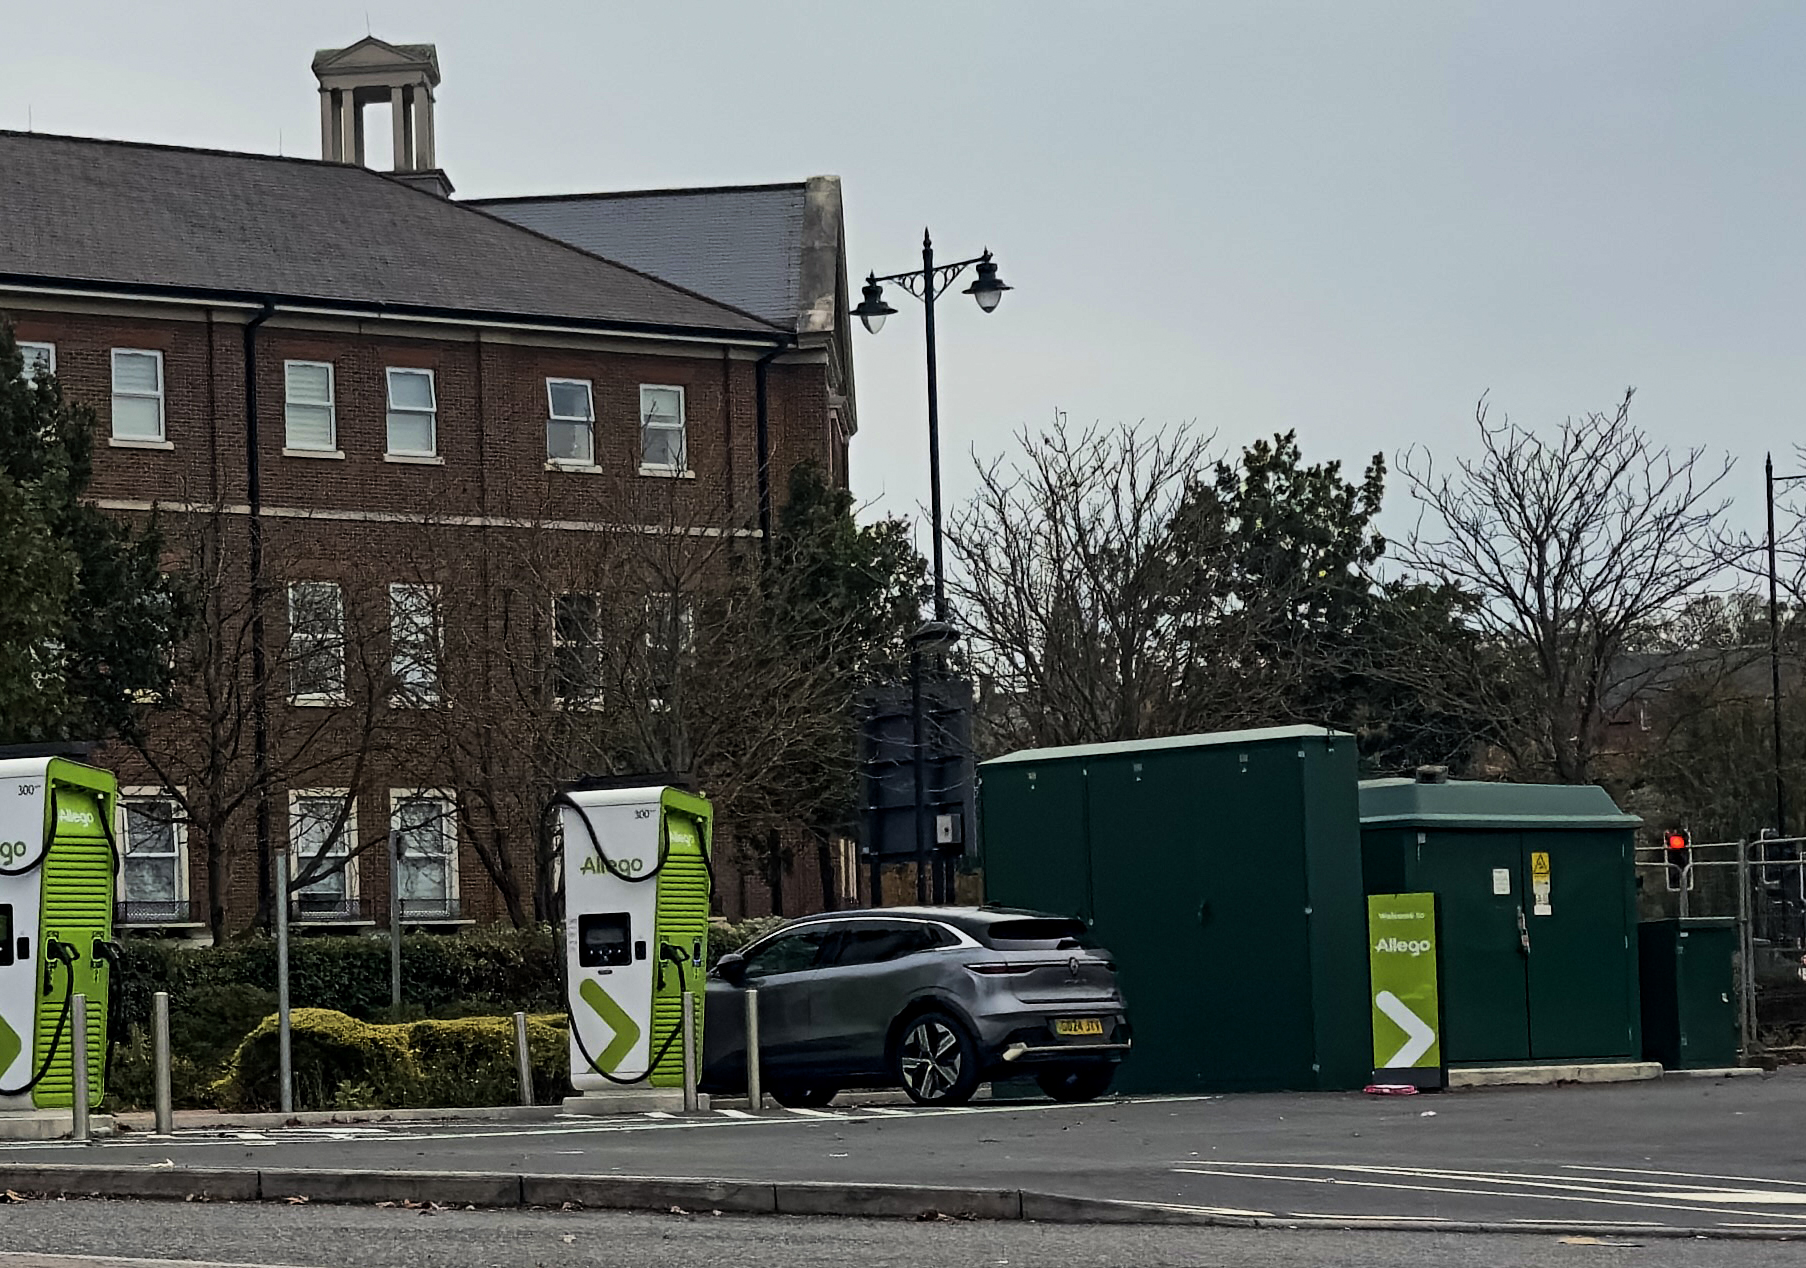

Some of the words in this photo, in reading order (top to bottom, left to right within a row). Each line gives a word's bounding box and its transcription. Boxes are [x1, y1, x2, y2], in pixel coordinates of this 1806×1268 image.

[18, 784, 35, 796] 300
[58, 808, 95, 828] Allego
[1375, 937, 1431, 957] Allego
